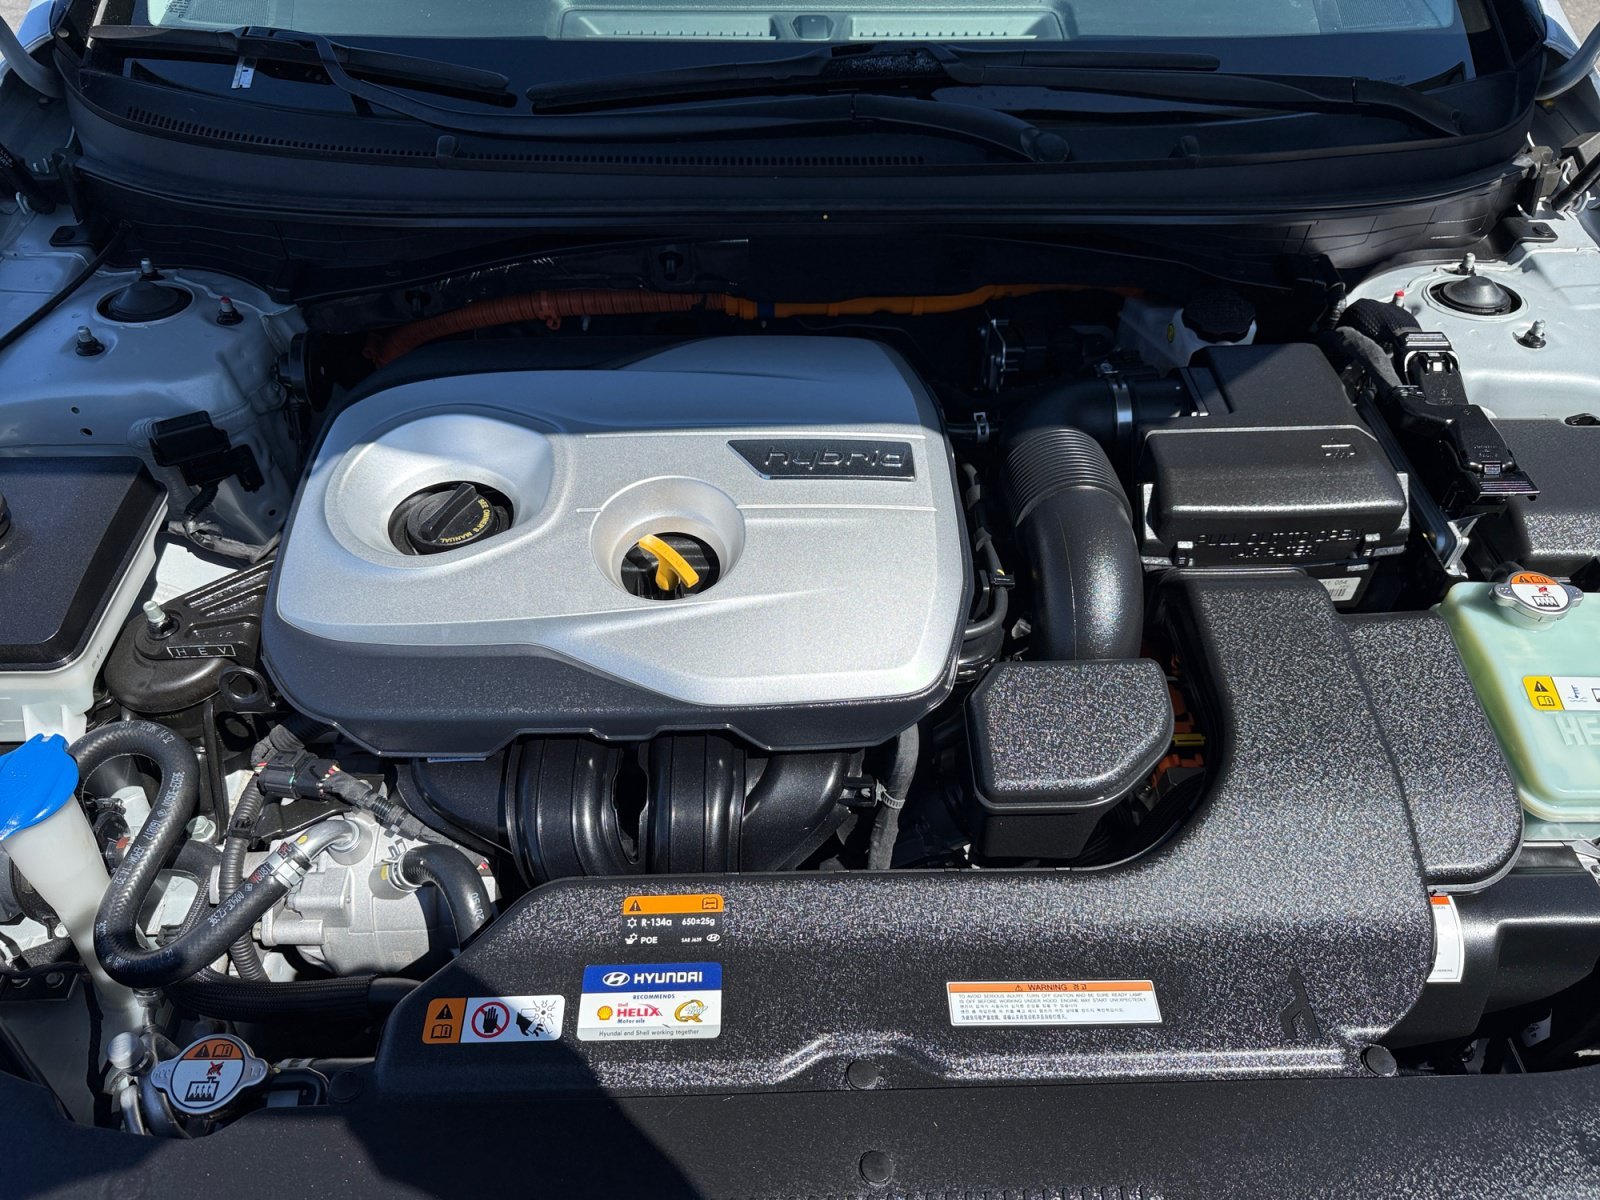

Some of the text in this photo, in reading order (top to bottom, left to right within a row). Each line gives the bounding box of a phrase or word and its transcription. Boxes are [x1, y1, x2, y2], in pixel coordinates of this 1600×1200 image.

[764, 446, 906, 470] hybrid
[478, 499, 489, 509] SEE
[440, 532, 473, 543] MANUAL
[641, 917, 716, 927] R-134a 650±25g
[640, 936, 658, 944] POE
[633, 971, 703, 984] HYUNDAI
[1027, 983, 1068, 991] WARNING
[1073, 983, 1087, 991] 경고
[617, 1007, 661, 1018] HELIX
[598, 1029, 622, 1037] Hyundai
[651, 1029, 674, 1037] working
[675, 1028, 700, 1036] together
